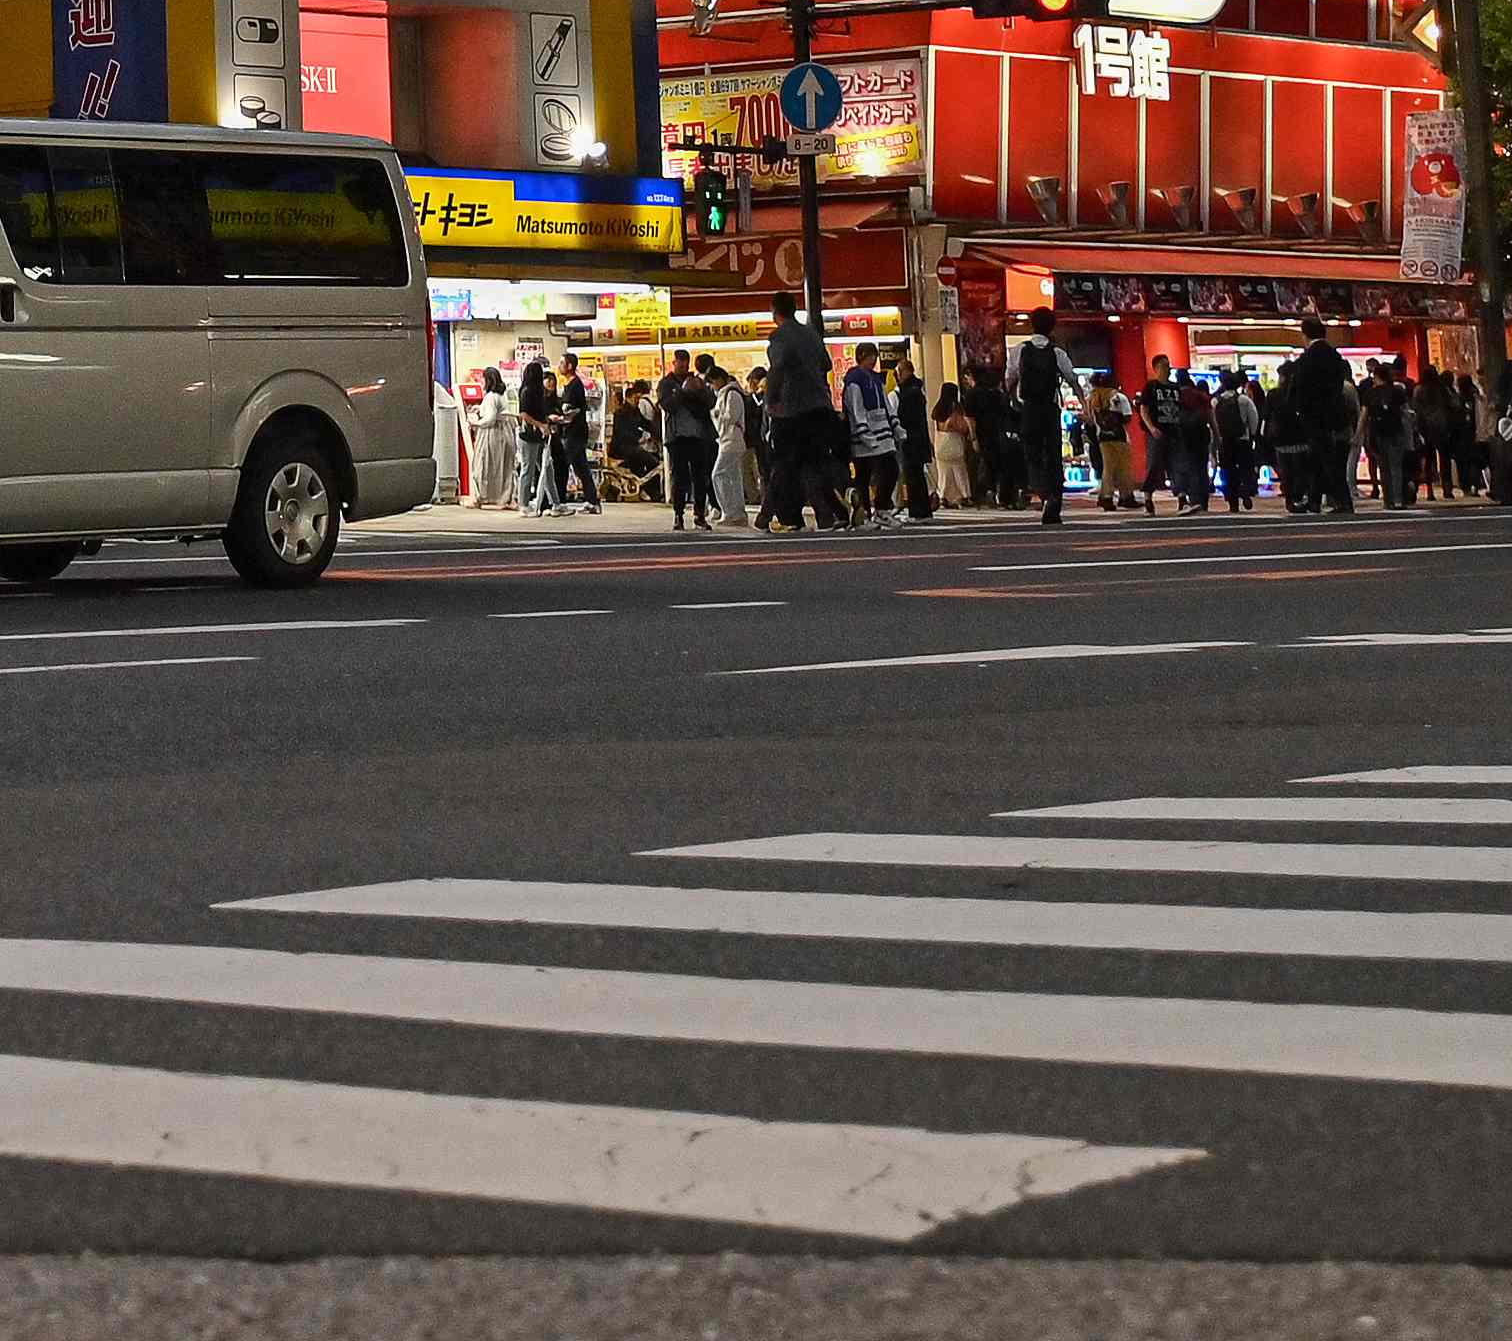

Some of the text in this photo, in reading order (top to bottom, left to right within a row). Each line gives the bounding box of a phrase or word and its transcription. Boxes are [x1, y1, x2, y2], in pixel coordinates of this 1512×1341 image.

[1074, 23, 1172, 102] 1号館
[298, 63, 338, 95] SK-II
[837, 68, 914, 94] フトカード
[794, 138, 829, 151] 8-20
